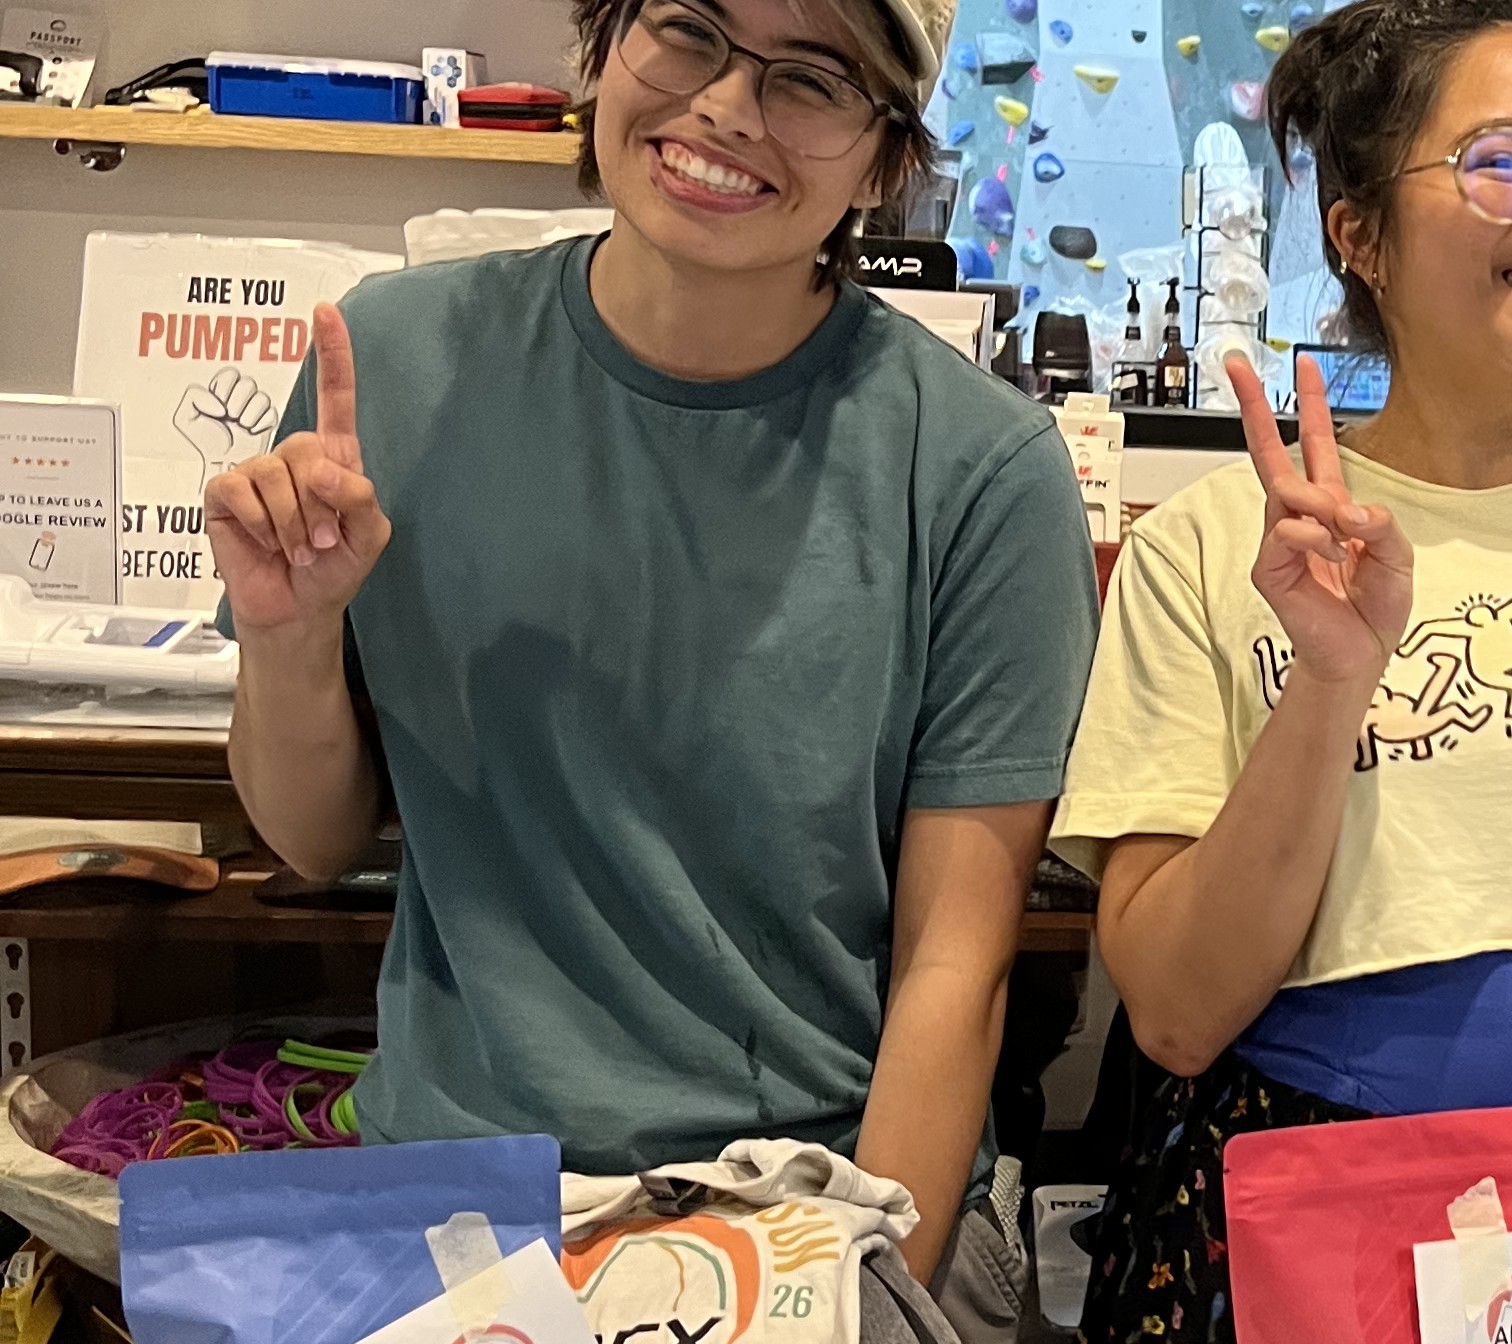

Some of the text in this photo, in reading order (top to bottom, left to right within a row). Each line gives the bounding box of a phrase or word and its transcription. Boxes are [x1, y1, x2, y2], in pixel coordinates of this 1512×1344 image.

[30, 31, 82, 46] PASSPORT
[187, 276, 286, 306] ARE YOU
[138, 312, 312, 363] PUMPED
[31, 434, 74, 445] SUPPORT
[9, 495, 26, 505] TO
[30, 496, 70, 507] LEAVE
[74, 498, 91, 508] US
[94, 499, 103, 508] A
[48, 515, 107, 528] REVIEW
[156, 505, 207, 535] YOU
[123, 550, 203, 579] BEFORE
[768, 1283, 814, 1319] 26
